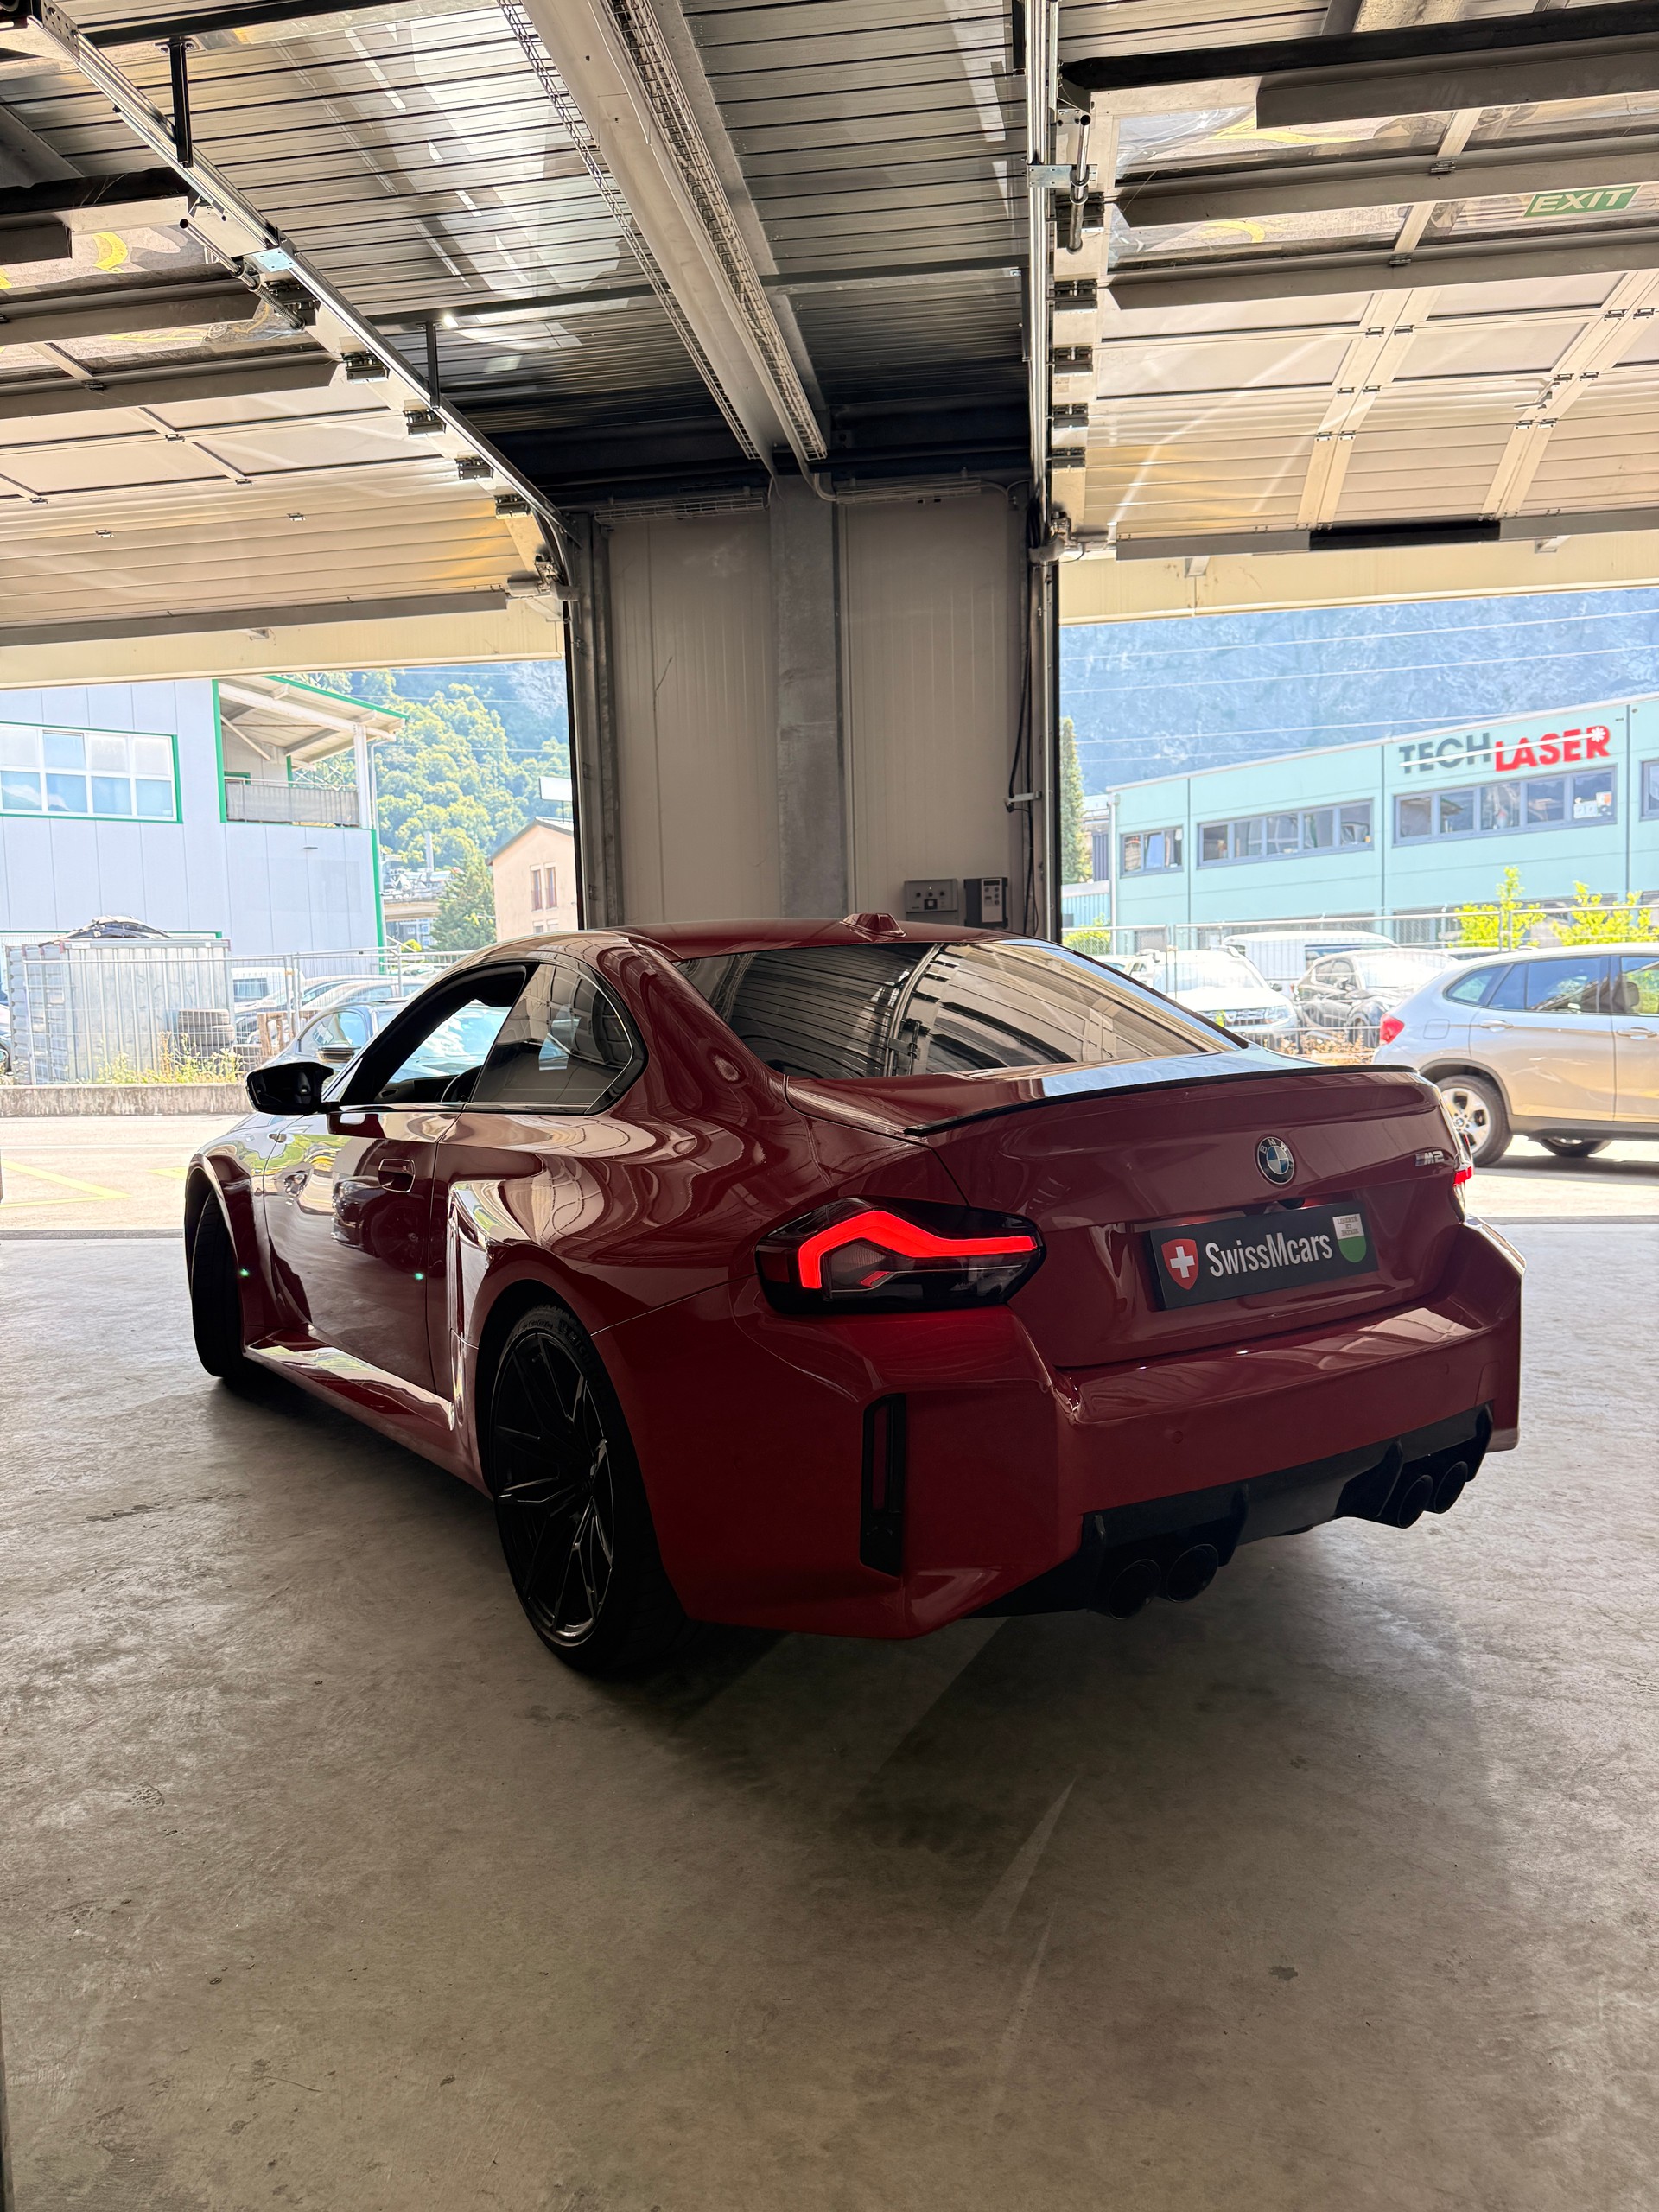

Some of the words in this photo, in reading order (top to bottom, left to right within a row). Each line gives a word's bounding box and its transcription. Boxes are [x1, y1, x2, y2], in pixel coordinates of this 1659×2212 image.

[1530, 188, 1633, 213] EXIT
[1423, 1150, 1445, 1166] M2
[1205, 1232, 1333, 1277] SwissMcars
